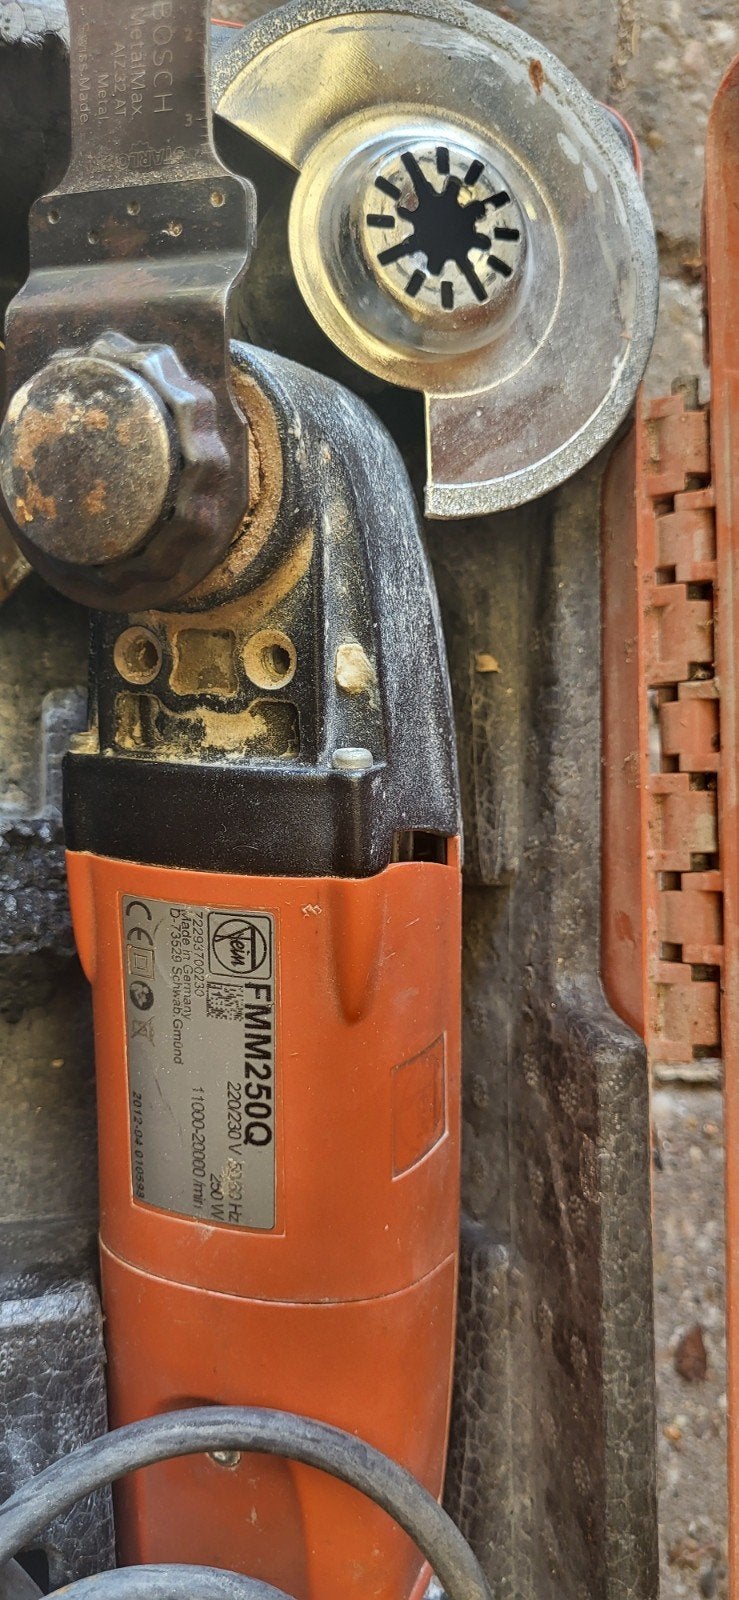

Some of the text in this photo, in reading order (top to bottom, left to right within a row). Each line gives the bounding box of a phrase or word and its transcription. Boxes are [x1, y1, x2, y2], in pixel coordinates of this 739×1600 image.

[114, 73, 127, 93] 32
[129, 7, 147, 116] MetalMax
[152, 2, 174, 114] BOSCH
[79, 77, 91, 124] Made
[97, 74, 110, 120] Metal
[114, 98, 127, 117] AT
[184, 113, 194, 128] 3
[169, 907, 183, 963] D-73529
[192, 911, 205, 998] 72293700230
[180, 909, 194, 1020] Made in Germany
[244, 982, 273, 1147] FMM250Q
[131, 1091, 144, 1146] 2012-04
[226, 1080, 243, 1140] 220/230
[190, 1087, 206, 1210] 11000-20000 /min
[228, 1143, 243, 1156] V
[209, 1173, 225, 1221] 250 W
[227, 1203, 243, 1223] Hz
